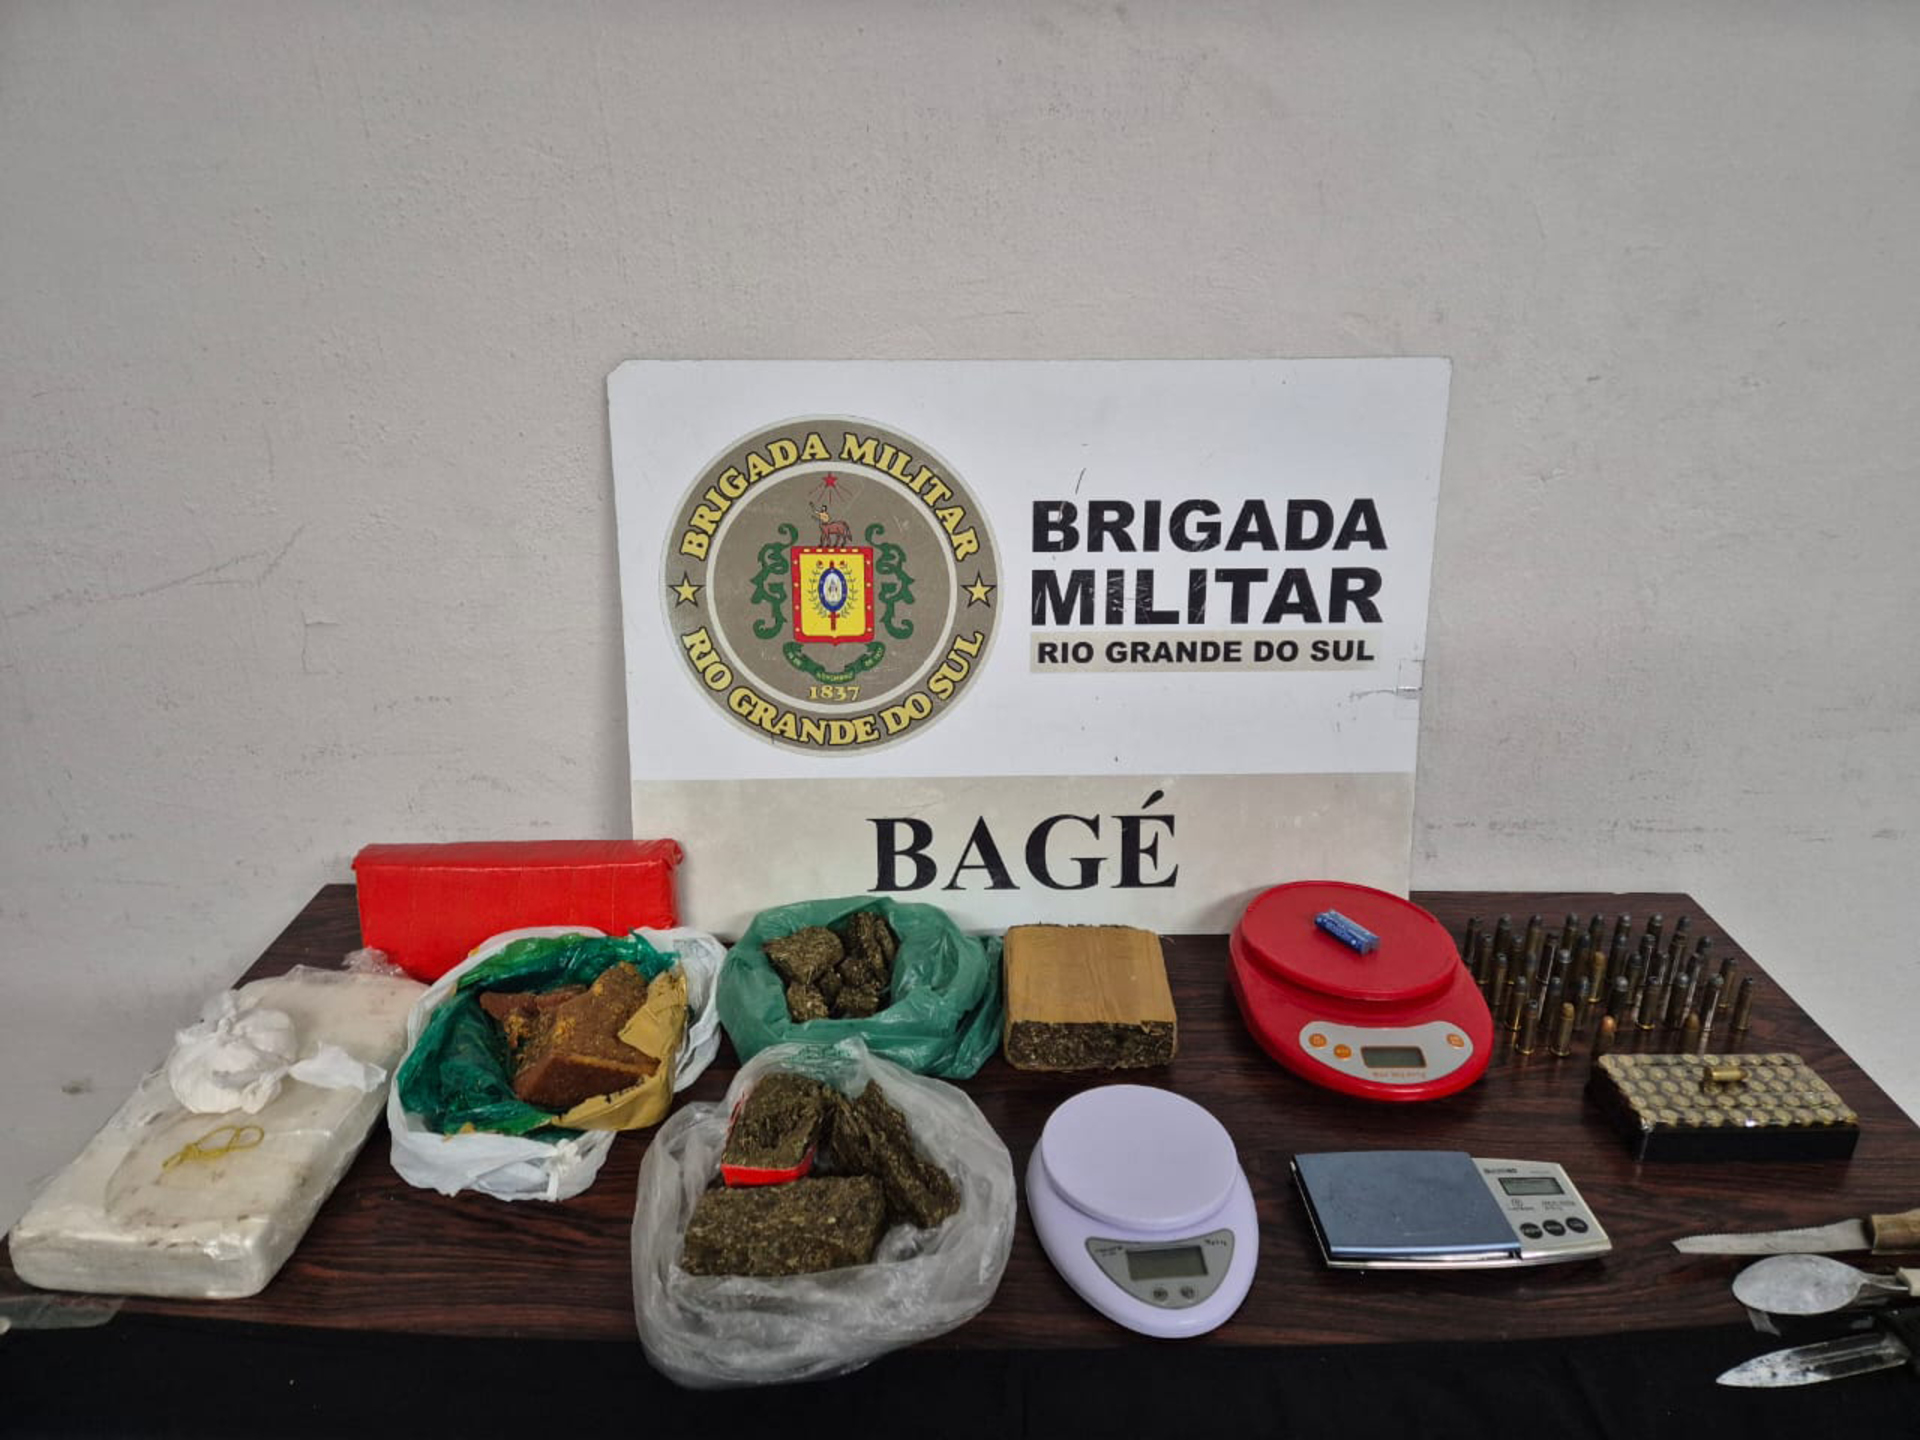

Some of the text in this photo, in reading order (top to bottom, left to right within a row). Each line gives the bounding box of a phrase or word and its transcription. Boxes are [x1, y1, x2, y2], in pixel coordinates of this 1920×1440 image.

[680, 432, 980, 562] BRIGADA MILITAR
[1031, 498, 1388, 553] BRIGADA
[1031, 567, 1383, 626] MILITAR
[1037, 640, 1374, 664] RIO GRANDE DO SUL
[682, 628, 985, 747] RIO GRANDE DO SUL
[809, 685, 860, 701] 1837
[866, 789, 1179, 893] BAGÉ
